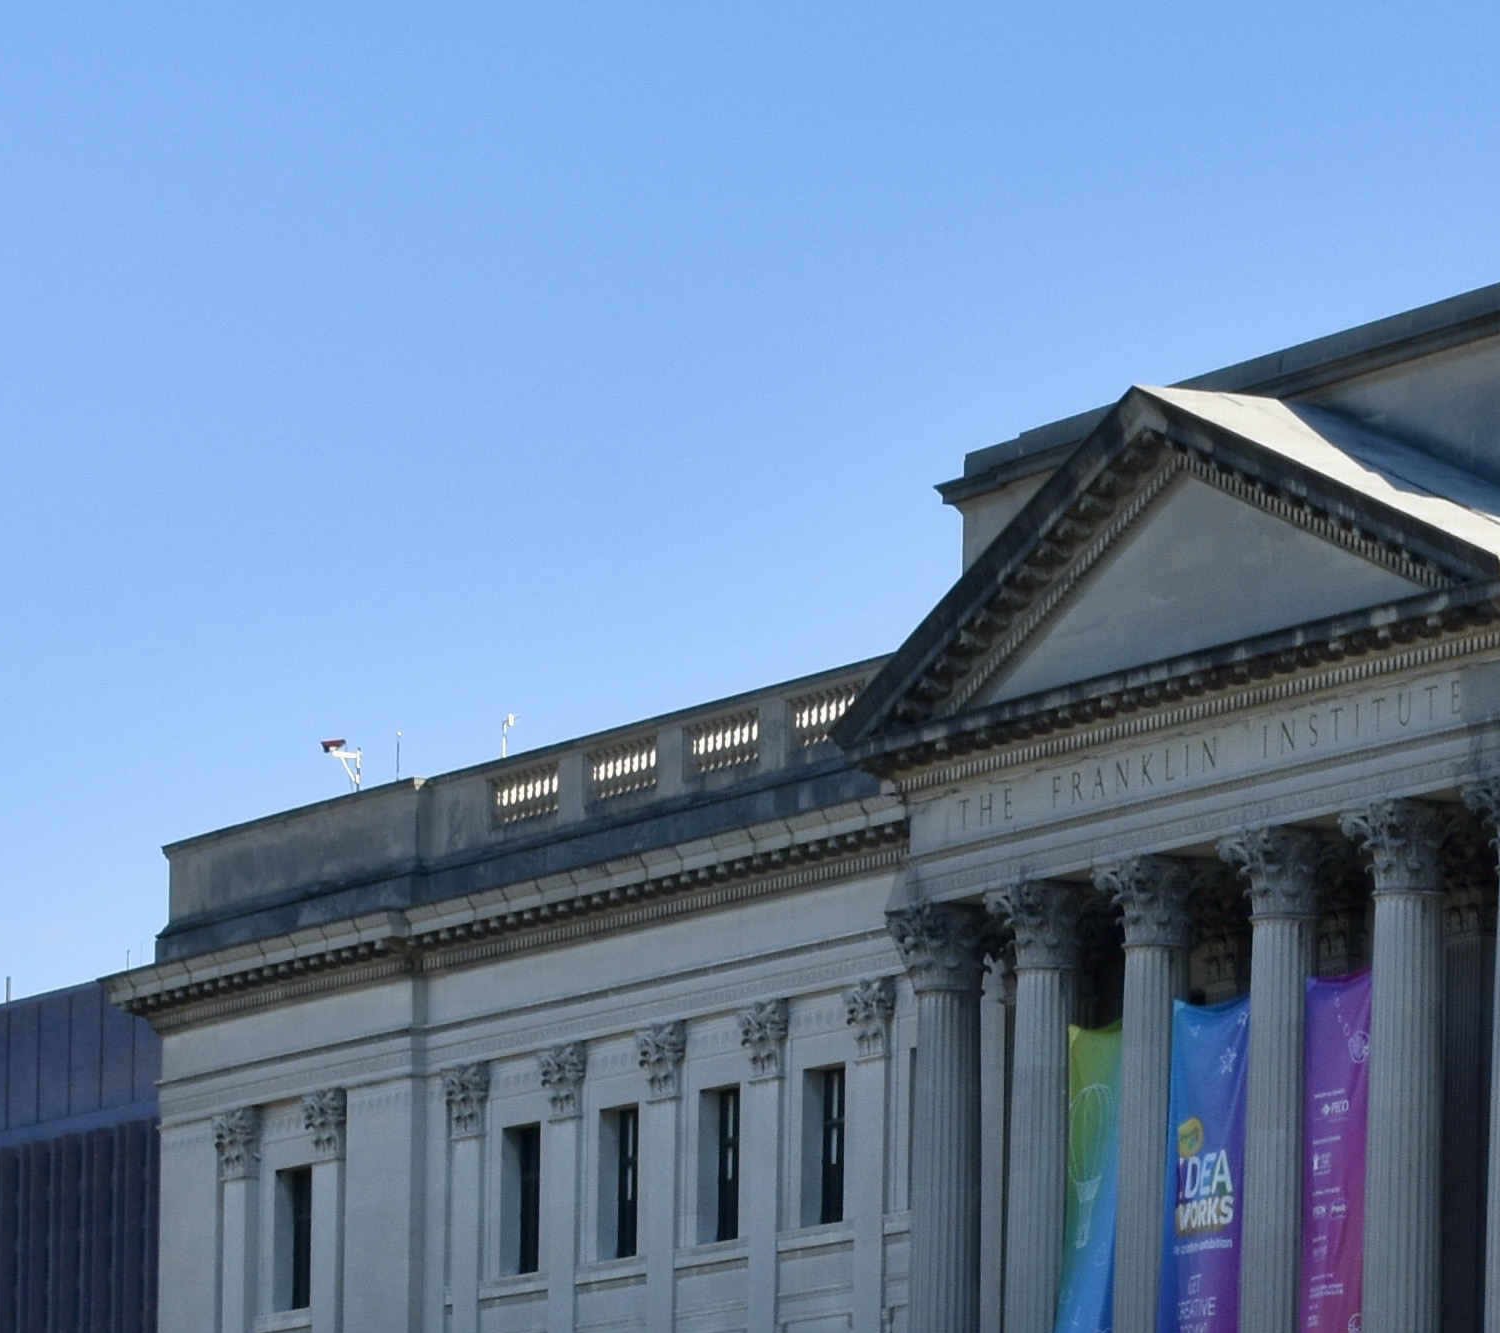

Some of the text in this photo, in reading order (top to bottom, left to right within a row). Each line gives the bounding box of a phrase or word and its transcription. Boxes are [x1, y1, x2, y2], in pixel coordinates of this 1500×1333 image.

[958, 680, 1461, 831] THE FRANKLIN INSTITUTE
